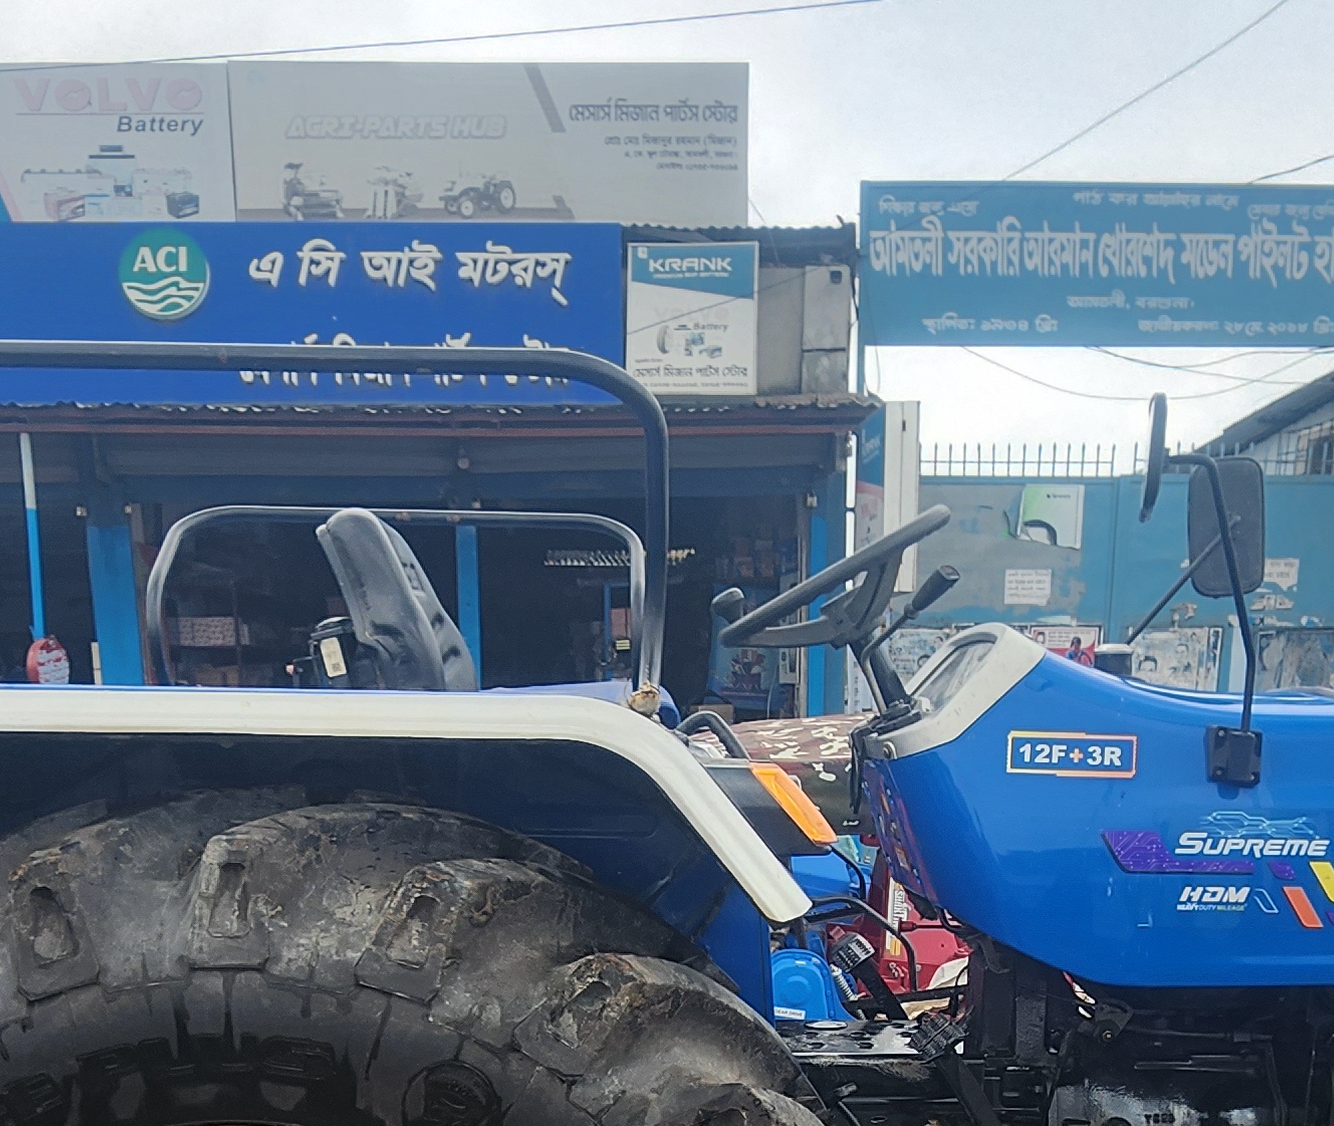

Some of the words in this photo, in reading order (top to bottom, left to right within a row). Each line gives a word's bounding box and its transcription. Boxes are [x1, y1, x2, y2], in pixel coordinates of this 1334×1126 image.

[569, 97, 612, 122] মেসার্স
[614, 98, 660, 122] মিজান
[117, 115, 203, 135] Battery
[450, 115, 508, 139] HUB
[132, 245, 188, 275] ACI
[248, 249, 284, 285] এ
[298, 237, 345, 289] সি
[362, 239, 443, 291] আই
[869, 215, 944, 277] আমতলী
[947, 215, 1022, 277] সরকারি
[1180, 232, 1236, 279] মডেল
[1237, 217, 1311, 289] পাইলট
[649, 257, 733, 272] KRANK
[1018, 743, 1122, 767] 12F+3R
[1175, 832, 1330, 858] SUPREME
[1178, 886, 1251, 903] HDM
